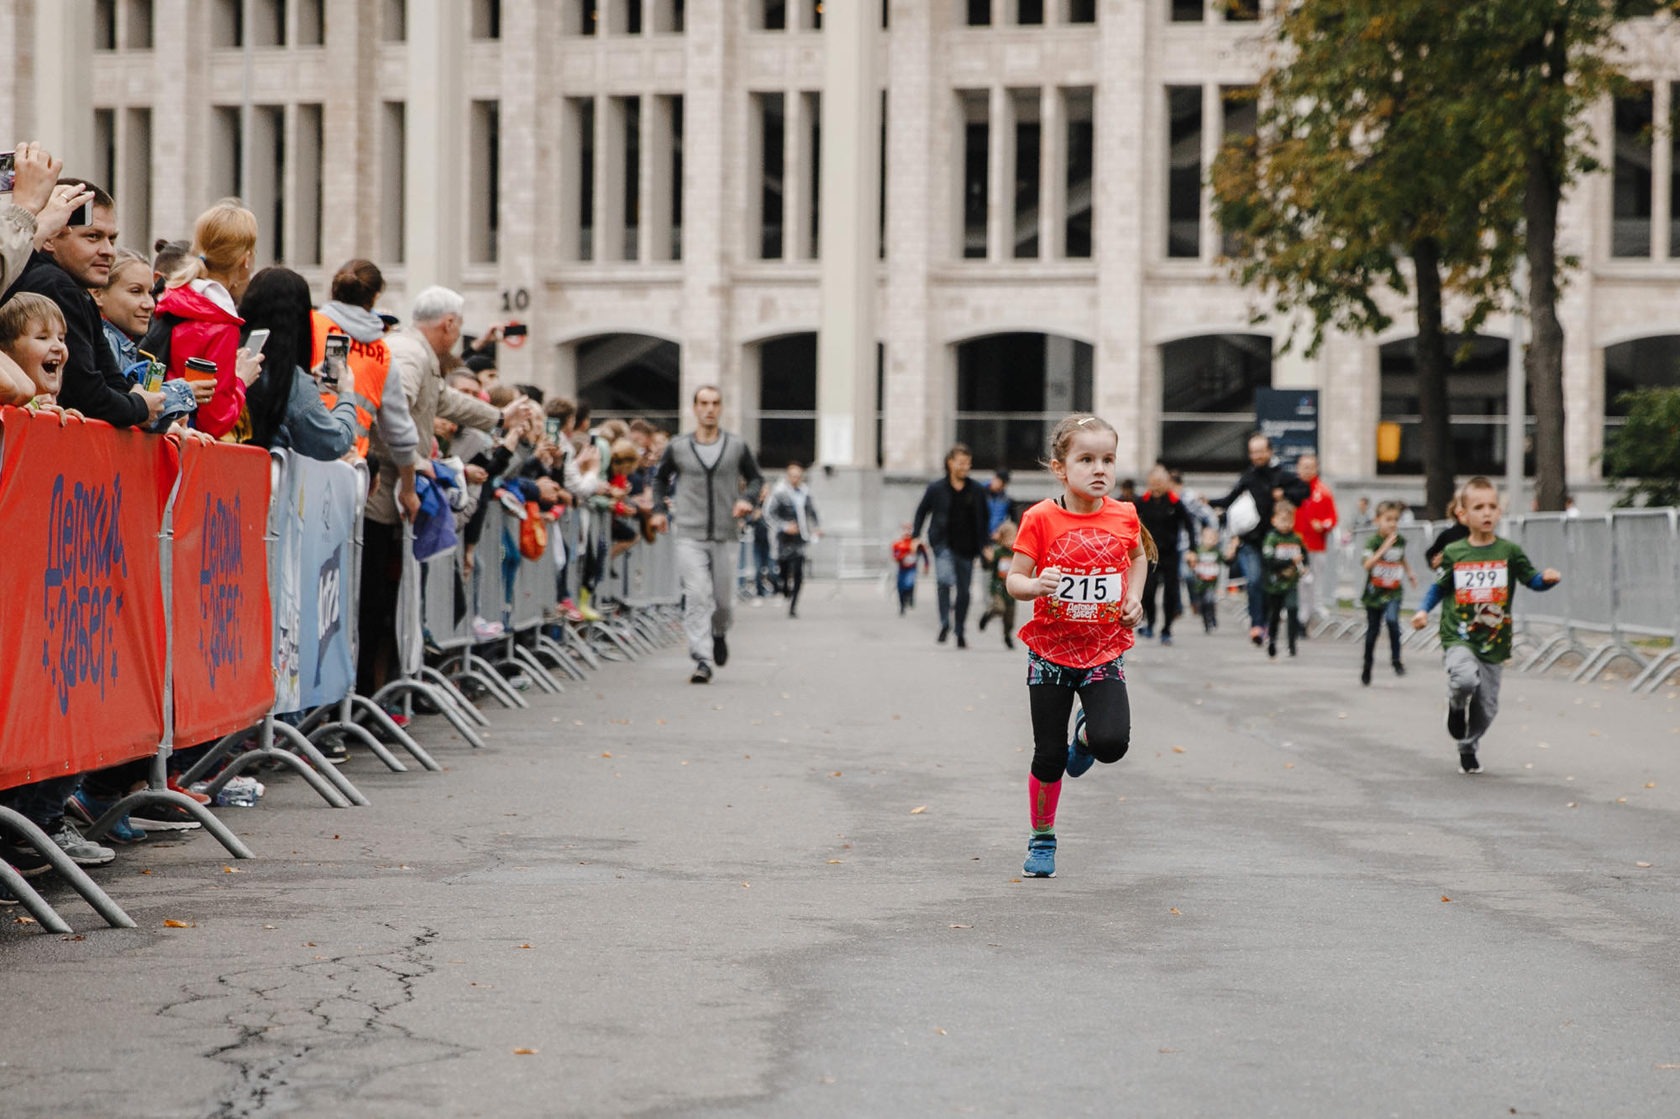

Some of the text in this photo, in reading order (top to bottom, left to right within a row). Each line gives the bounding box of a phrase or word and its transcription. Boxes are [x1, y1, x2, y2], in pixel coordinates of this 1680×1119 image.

[502, 288, 530, 312] 10
[44, 471, 127, 620] Детский
[1060, 577, 1107, 601] 215
[1465, 571, 1497, 588] 299
